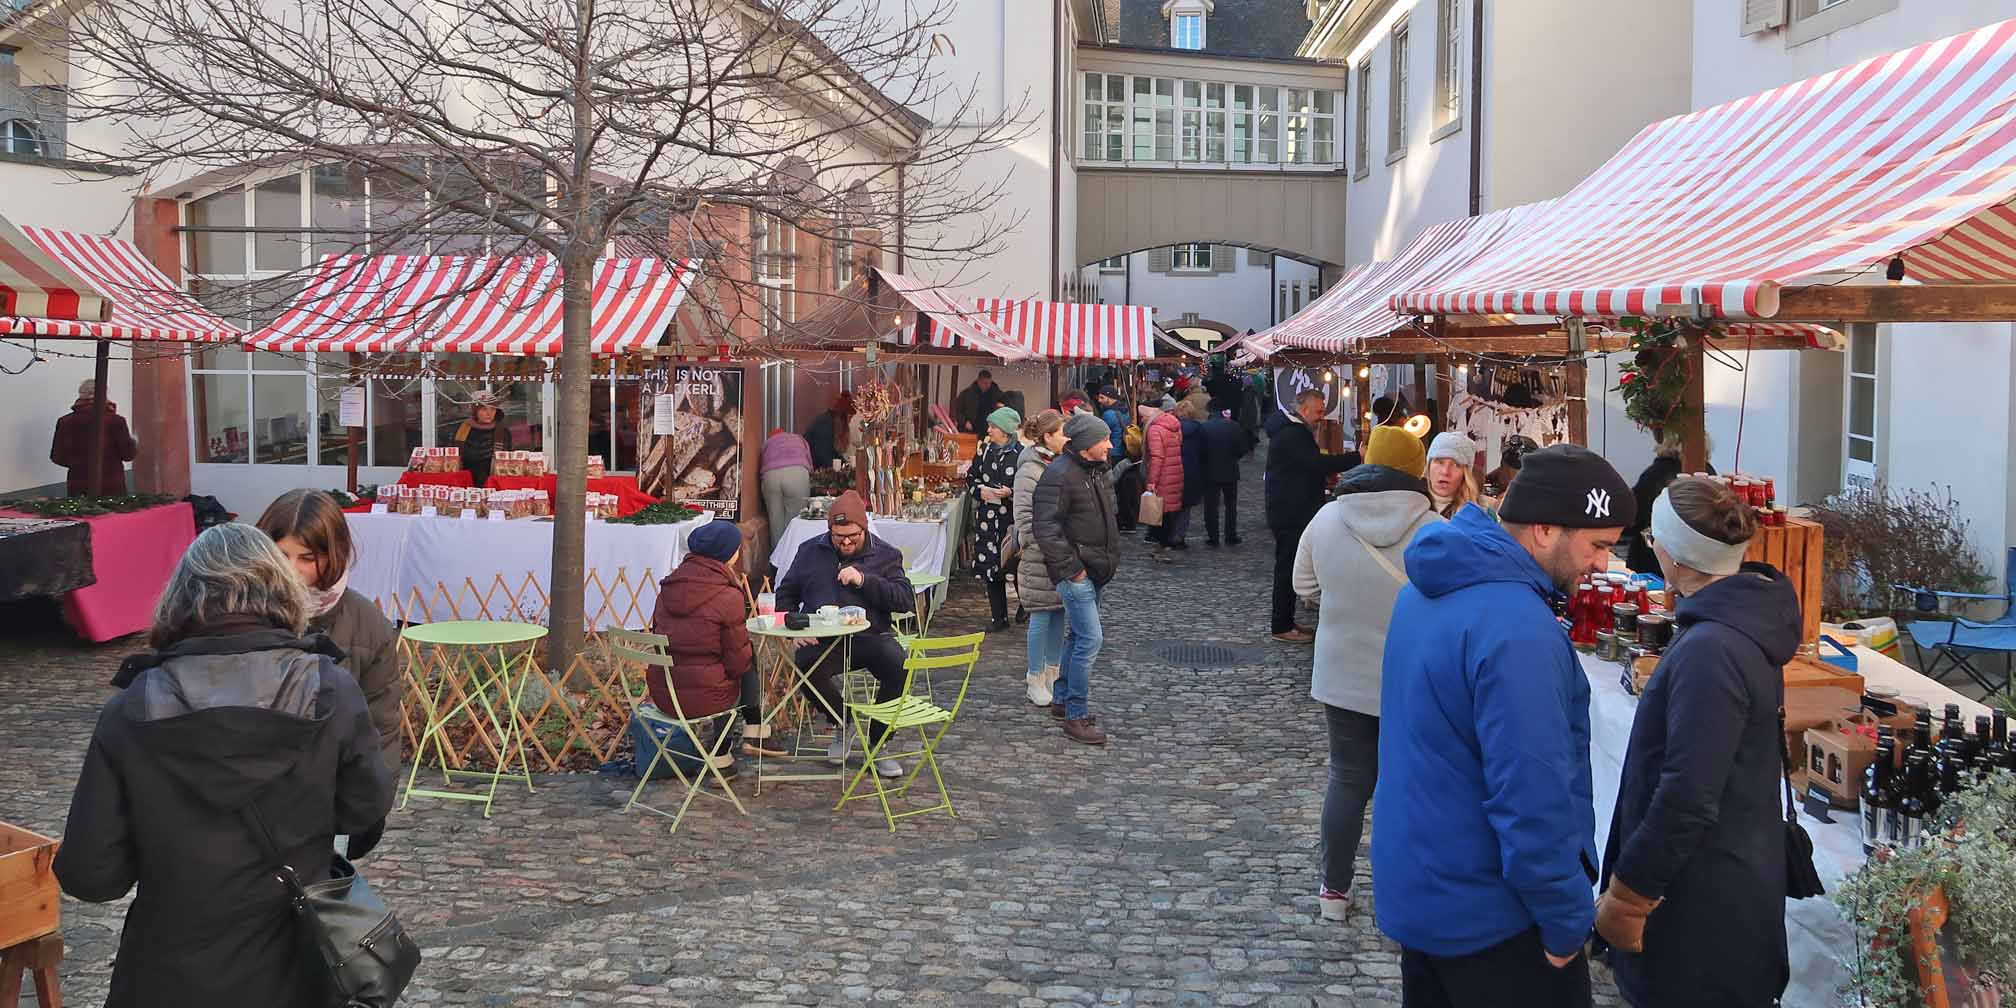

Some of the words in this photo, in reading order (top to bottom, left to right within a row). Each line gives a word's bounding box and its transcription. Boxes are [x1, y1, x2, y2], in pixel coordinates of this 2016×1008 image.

[676, 370, 688, 381] IS
[692, 371, 721, 382] NOT
[642, 382, 652, 393] A
[1585, 488, 1610, 518] NY
